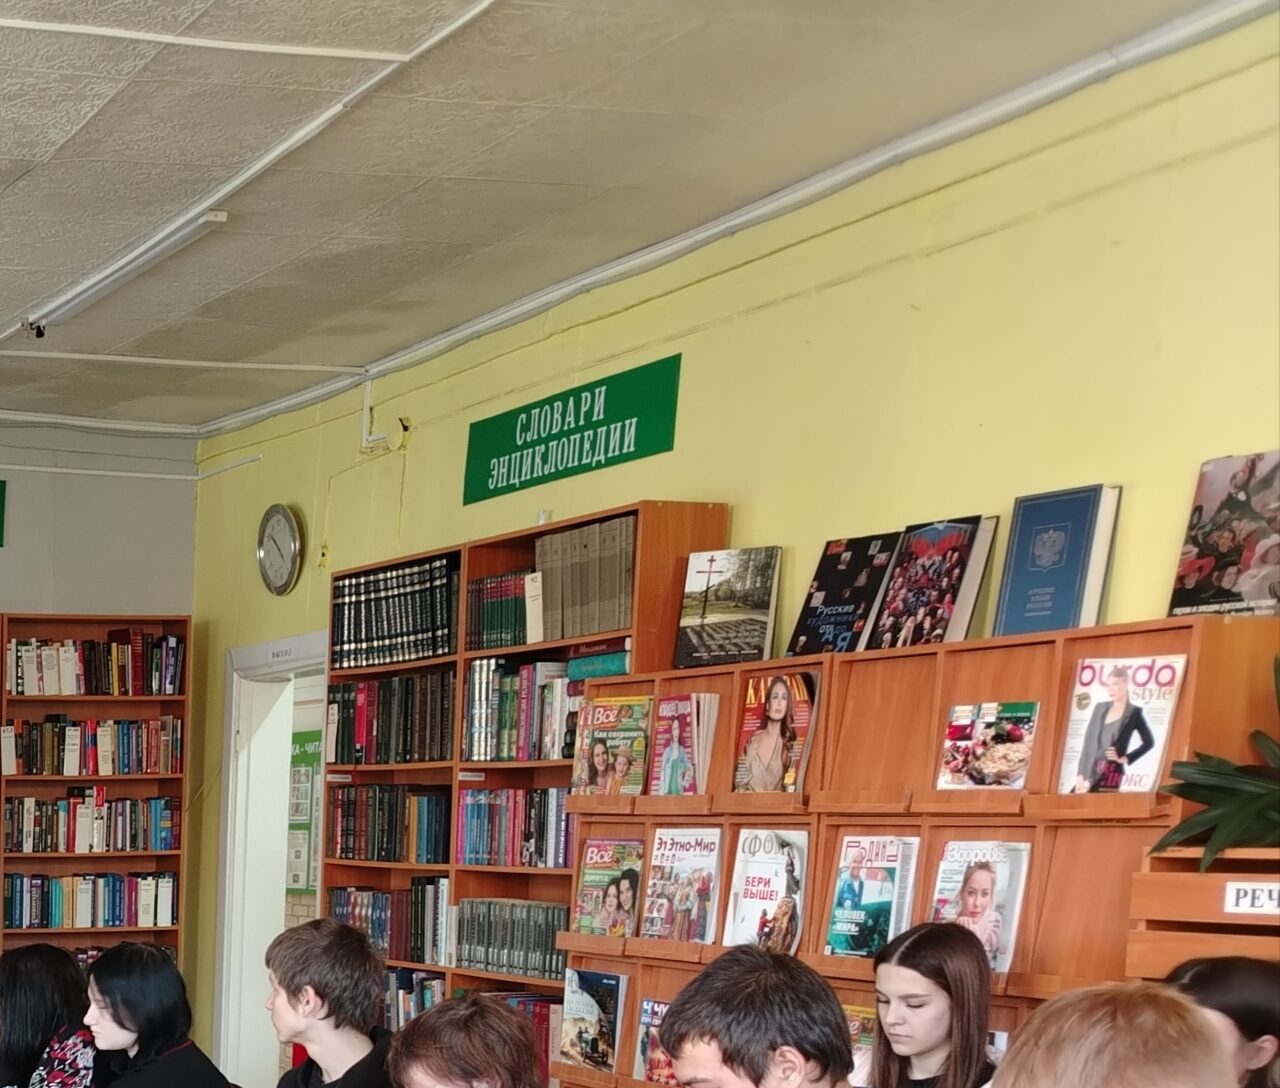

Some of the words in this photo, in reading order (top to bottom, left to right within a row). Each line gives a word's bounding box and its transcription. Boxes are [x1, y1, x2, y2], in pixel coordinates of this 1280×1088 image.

[516, 385, 607, 446] СЛОВАРИ
[488, 417, 638, 490] ЭНЦИКЛОПЕДИИ
[816, 604, 855, 616] Русские
[1131, 687, 1173, 705] style
[668, 837, 716, 854] Этно-Мир
[745, 876, 771, 888] БЕРИ
[743, 888, 779, 901] ВЫШЕ!
[1232, 887, 1280, 909] РЕЧ
